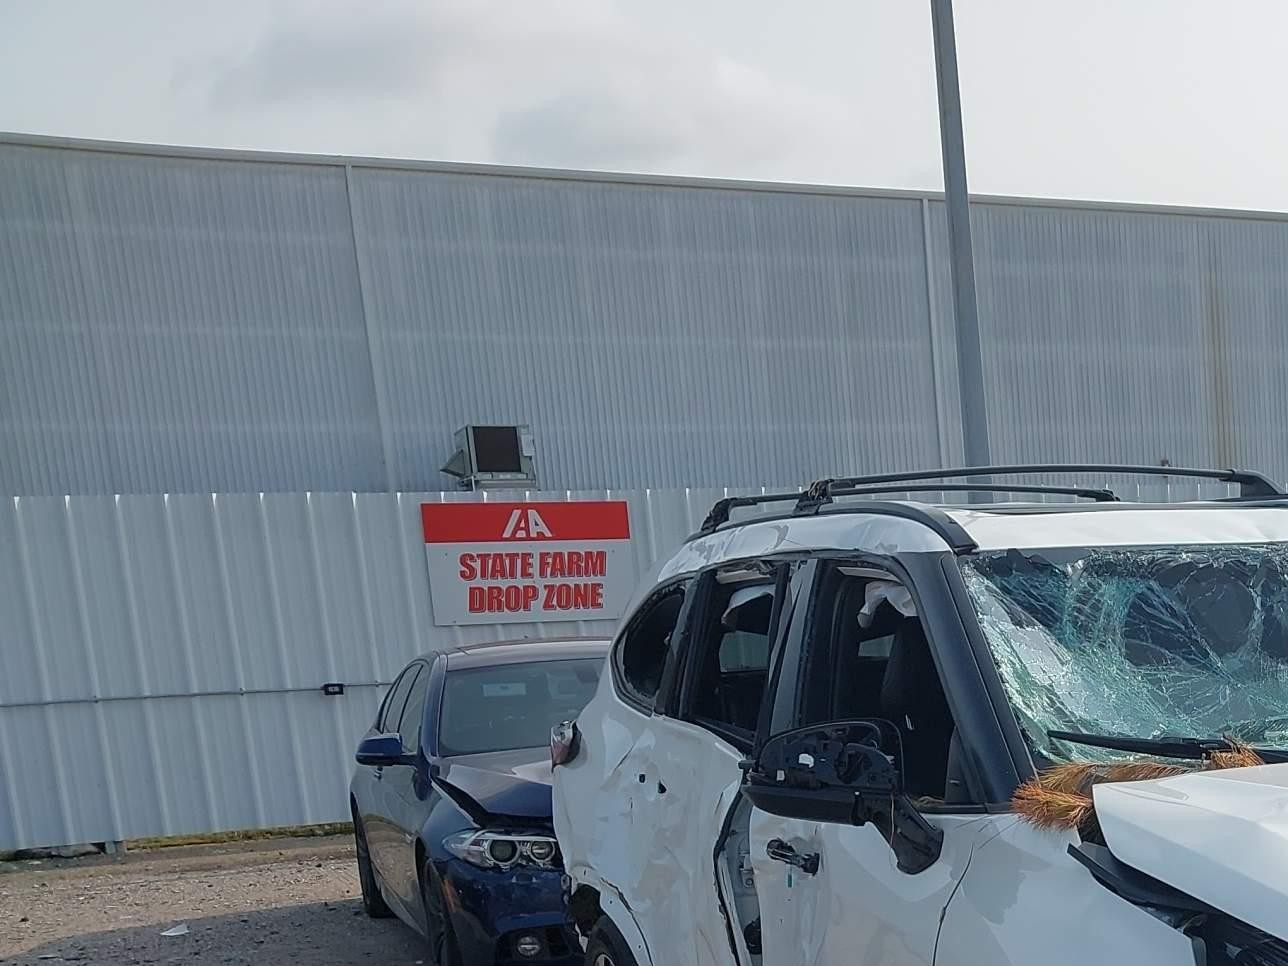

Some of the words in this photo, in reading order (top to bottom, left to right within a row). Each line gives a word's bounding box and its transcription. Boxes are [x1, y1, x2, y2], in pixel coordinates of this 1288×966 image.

[458, 552, 534, 581] STATE
[538, 550, 607, 577] FARM
[468, 584, 539, 614] DROP
[543, 583, 604, 611] ZONE
